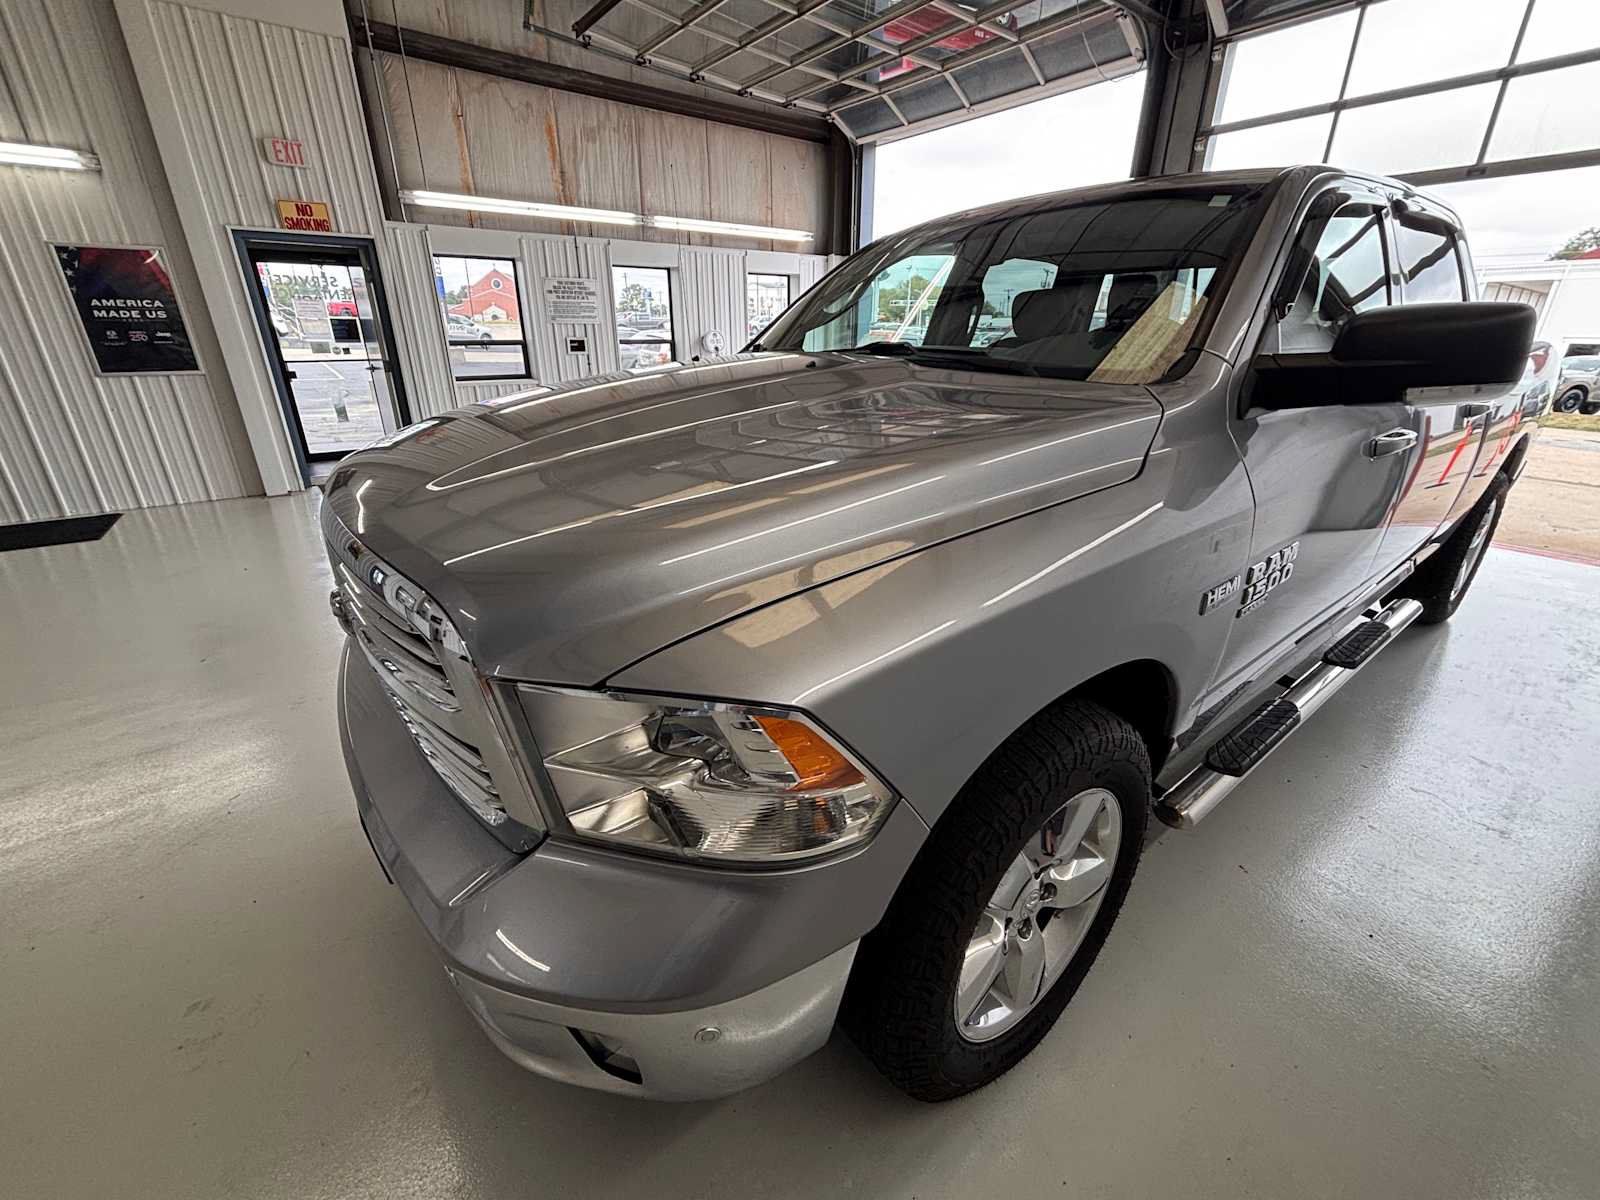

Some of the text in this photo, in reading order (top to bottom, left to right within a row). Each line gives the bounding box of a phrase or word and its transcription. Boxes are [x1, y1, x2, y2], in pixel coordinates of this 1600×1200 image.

[271, 139, 305, 166] EXIT
[295, 203, 314, 217] NO
[284, 216, 330, 232] SMOKING
[91, 298, 164, 308] AMERICA
[93, 309, 168, 319] MADE US
[1248, 541, 1300, 584] RAM
[1204, 575, 1241, 609] HEMI
[1243, 562, 1294, 605] 1500
